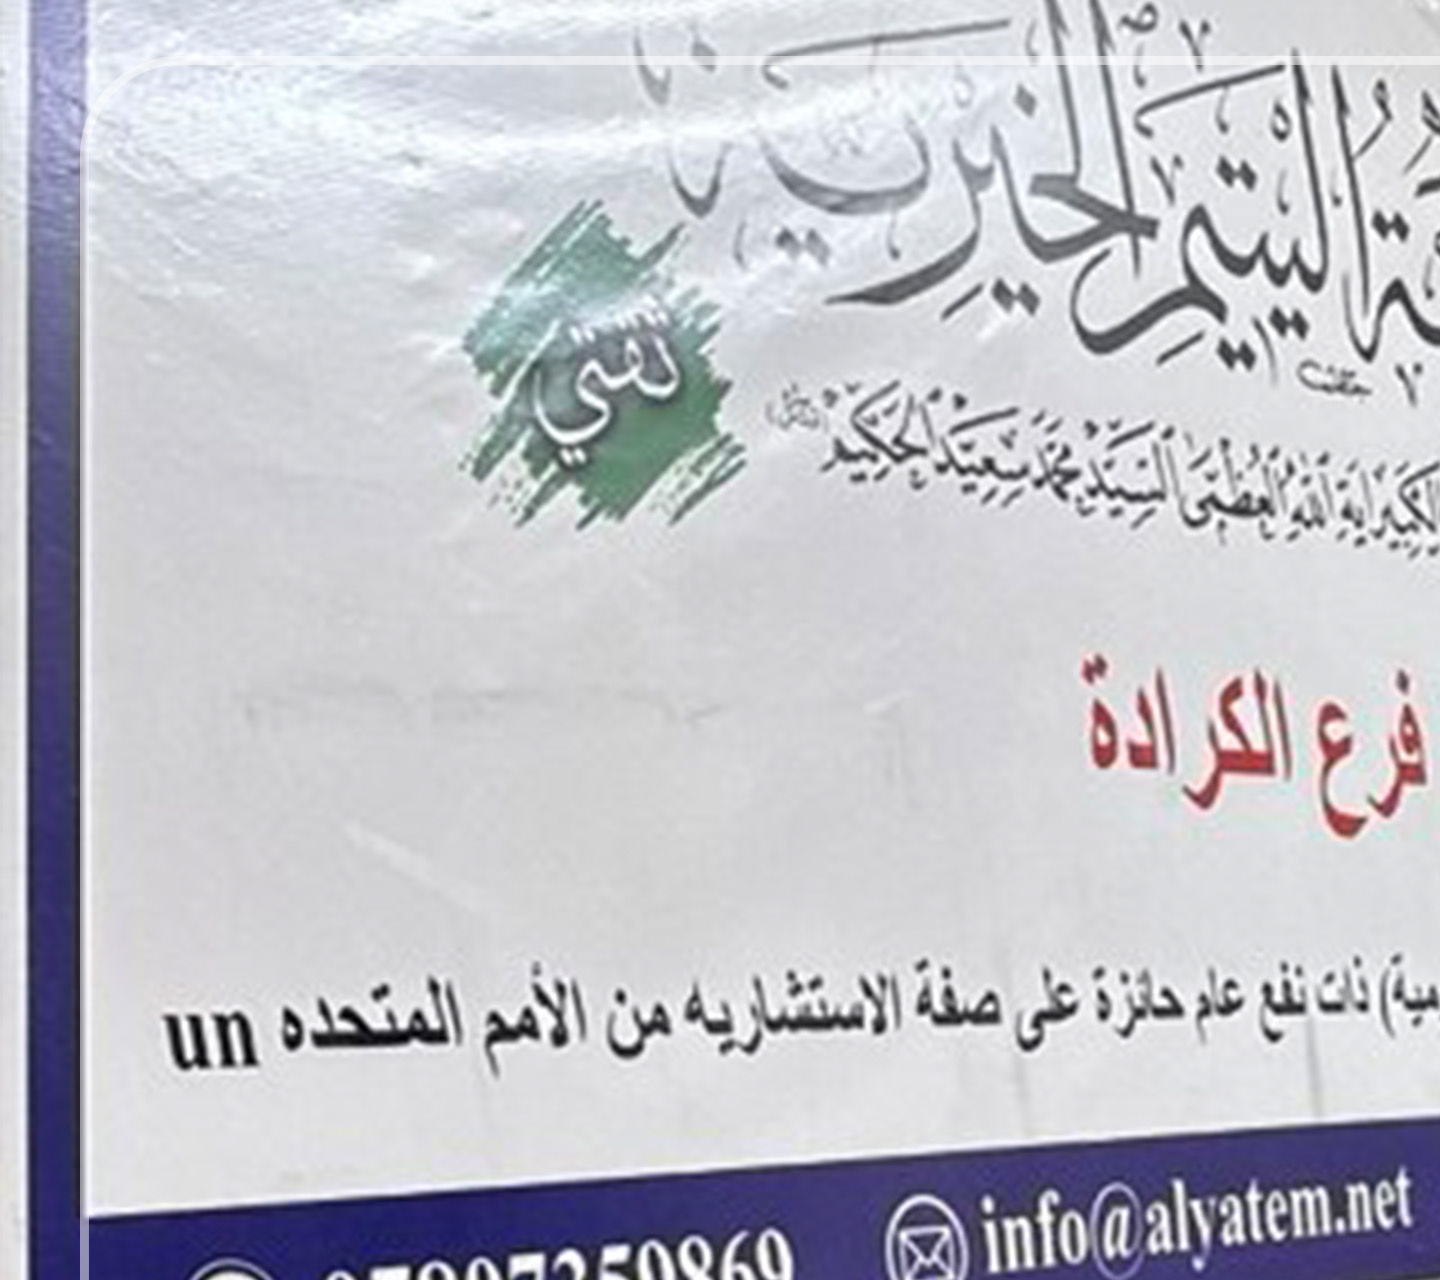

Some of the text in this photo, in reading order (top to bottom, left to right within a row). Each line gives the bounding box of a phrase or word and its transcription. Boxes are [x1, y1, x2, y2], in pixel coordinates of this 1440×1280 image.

[820, 378, 936, 494] الحكيم
[936, 392, 1034, 508] سعيد
[1088, 420, 1184, 530] السيد
[1081, 653, 1428, 840] فرع الكرادة
[281, 973, 464, 1053] المتحده
[483, 960, 588, 1079] الأمم
[606, 987, 673, 1060] من
[683, 967, 903, 1056] الاستشاريه
[914, 957, 1001, 1028] صفة
[1015, 965, 1081, 1053] على
[1092, 963, 1186, 1040] حائزة
[1195, 966, 1246, 1047] عام
[1259, 959, 1309, 1044] نفع
[1314, 954, 1371, 1015] ذات
[162, 1008, 261, 1073] un
